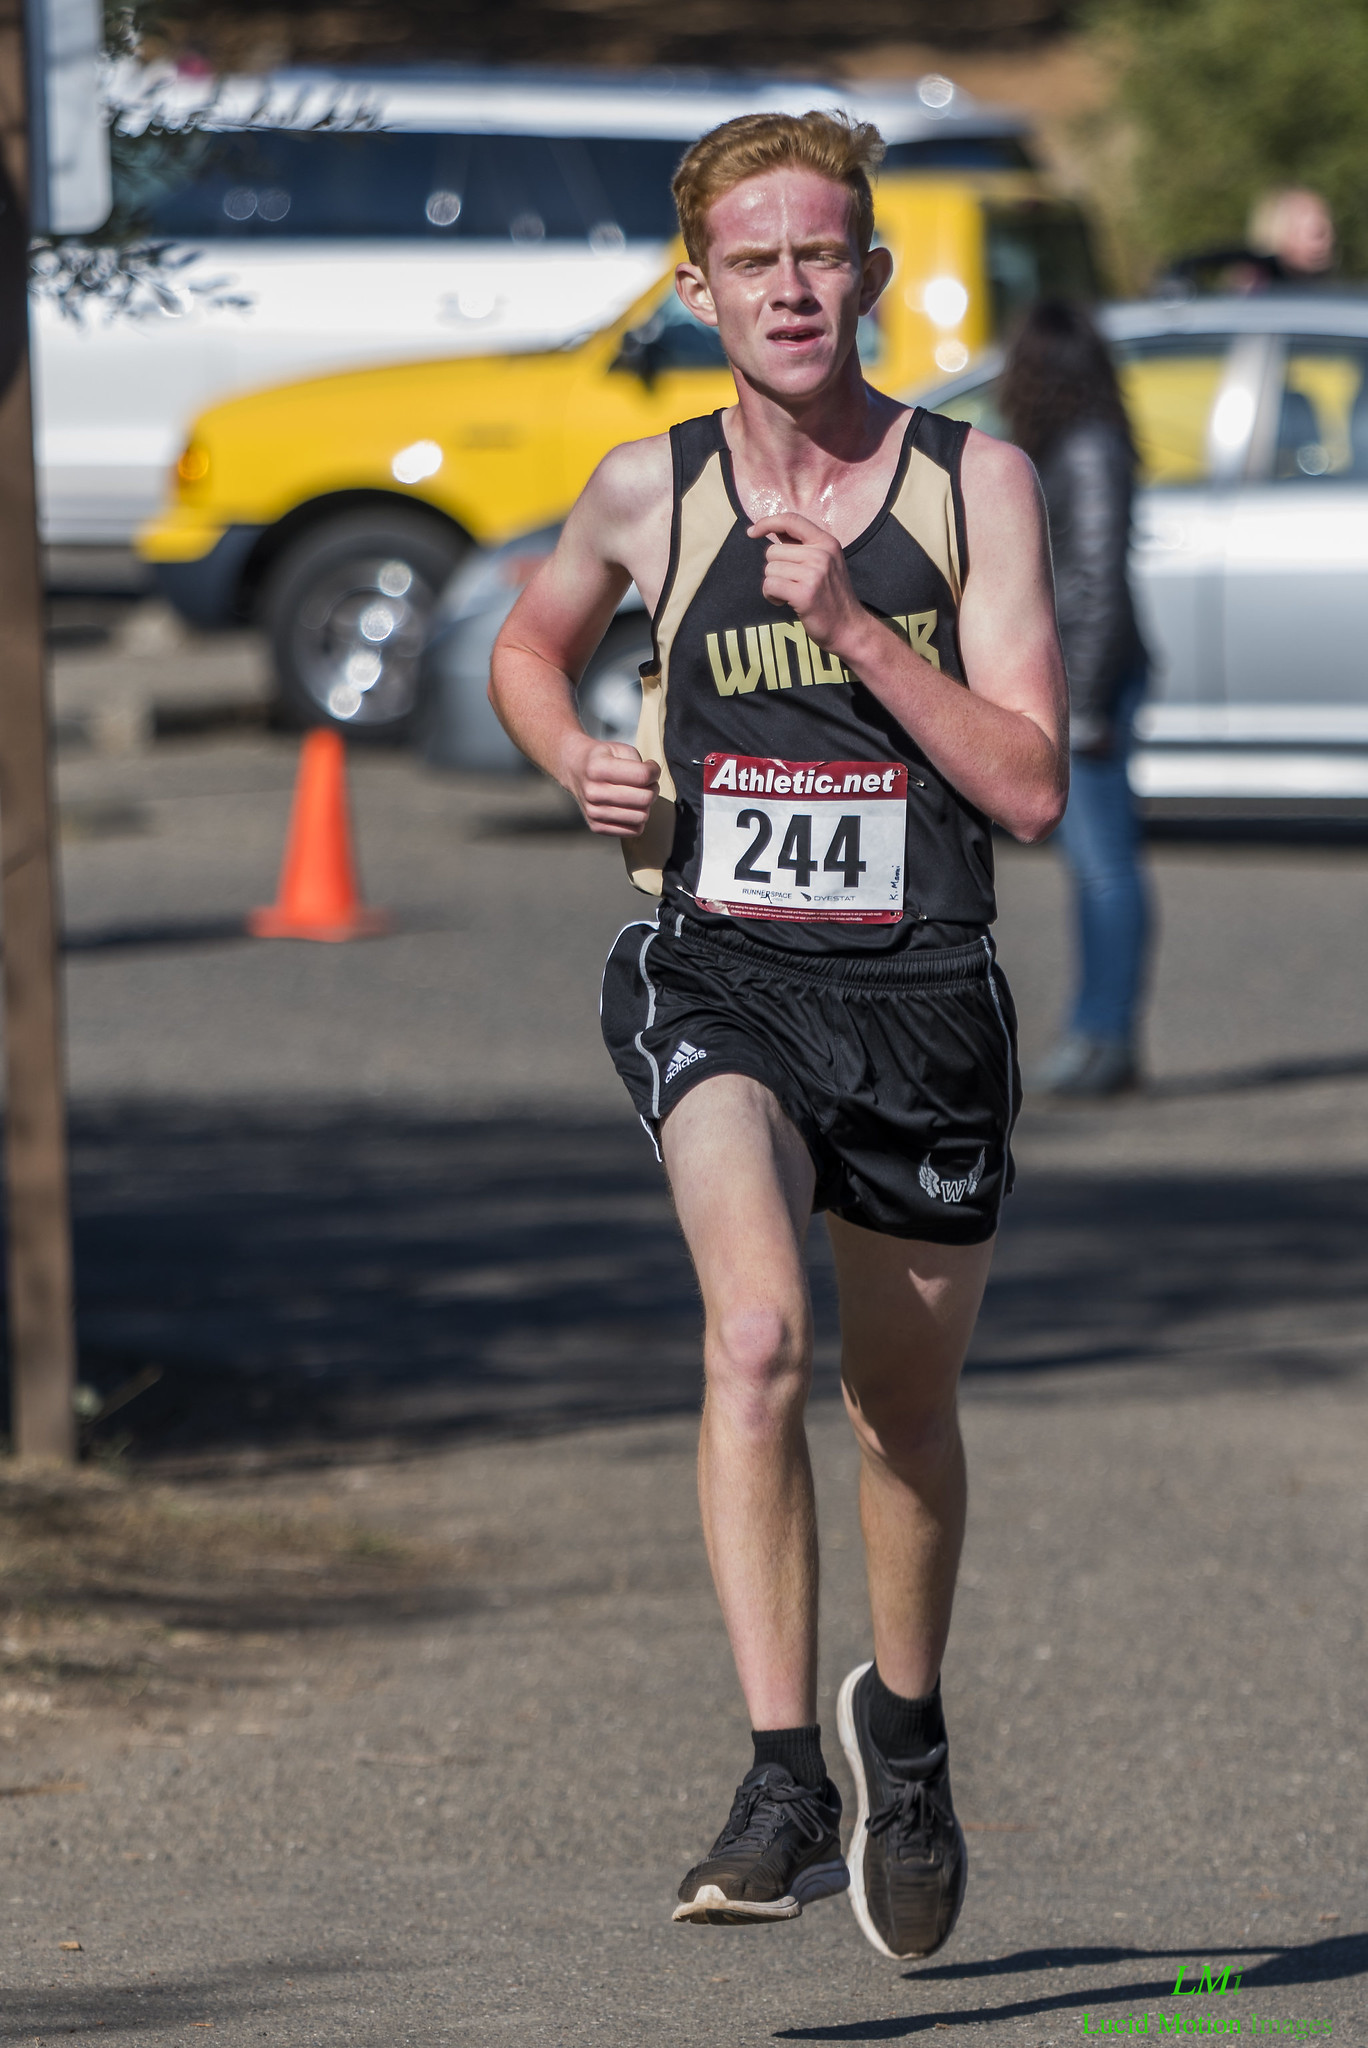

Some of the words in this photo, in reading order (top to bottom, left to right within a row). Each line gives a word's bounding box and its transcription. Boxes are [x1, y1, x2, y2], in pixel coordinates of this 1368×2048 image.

[706, 609, 941, 697] WINDR
[710, 759, 894, 794] Athletic.net
[734, 808, 867, 888] 244
[741, 888, 793, 900] RUNNERSPACE
[665, 1049, 707, 1084] adidas
[941, 1179, 967, 1203] W
